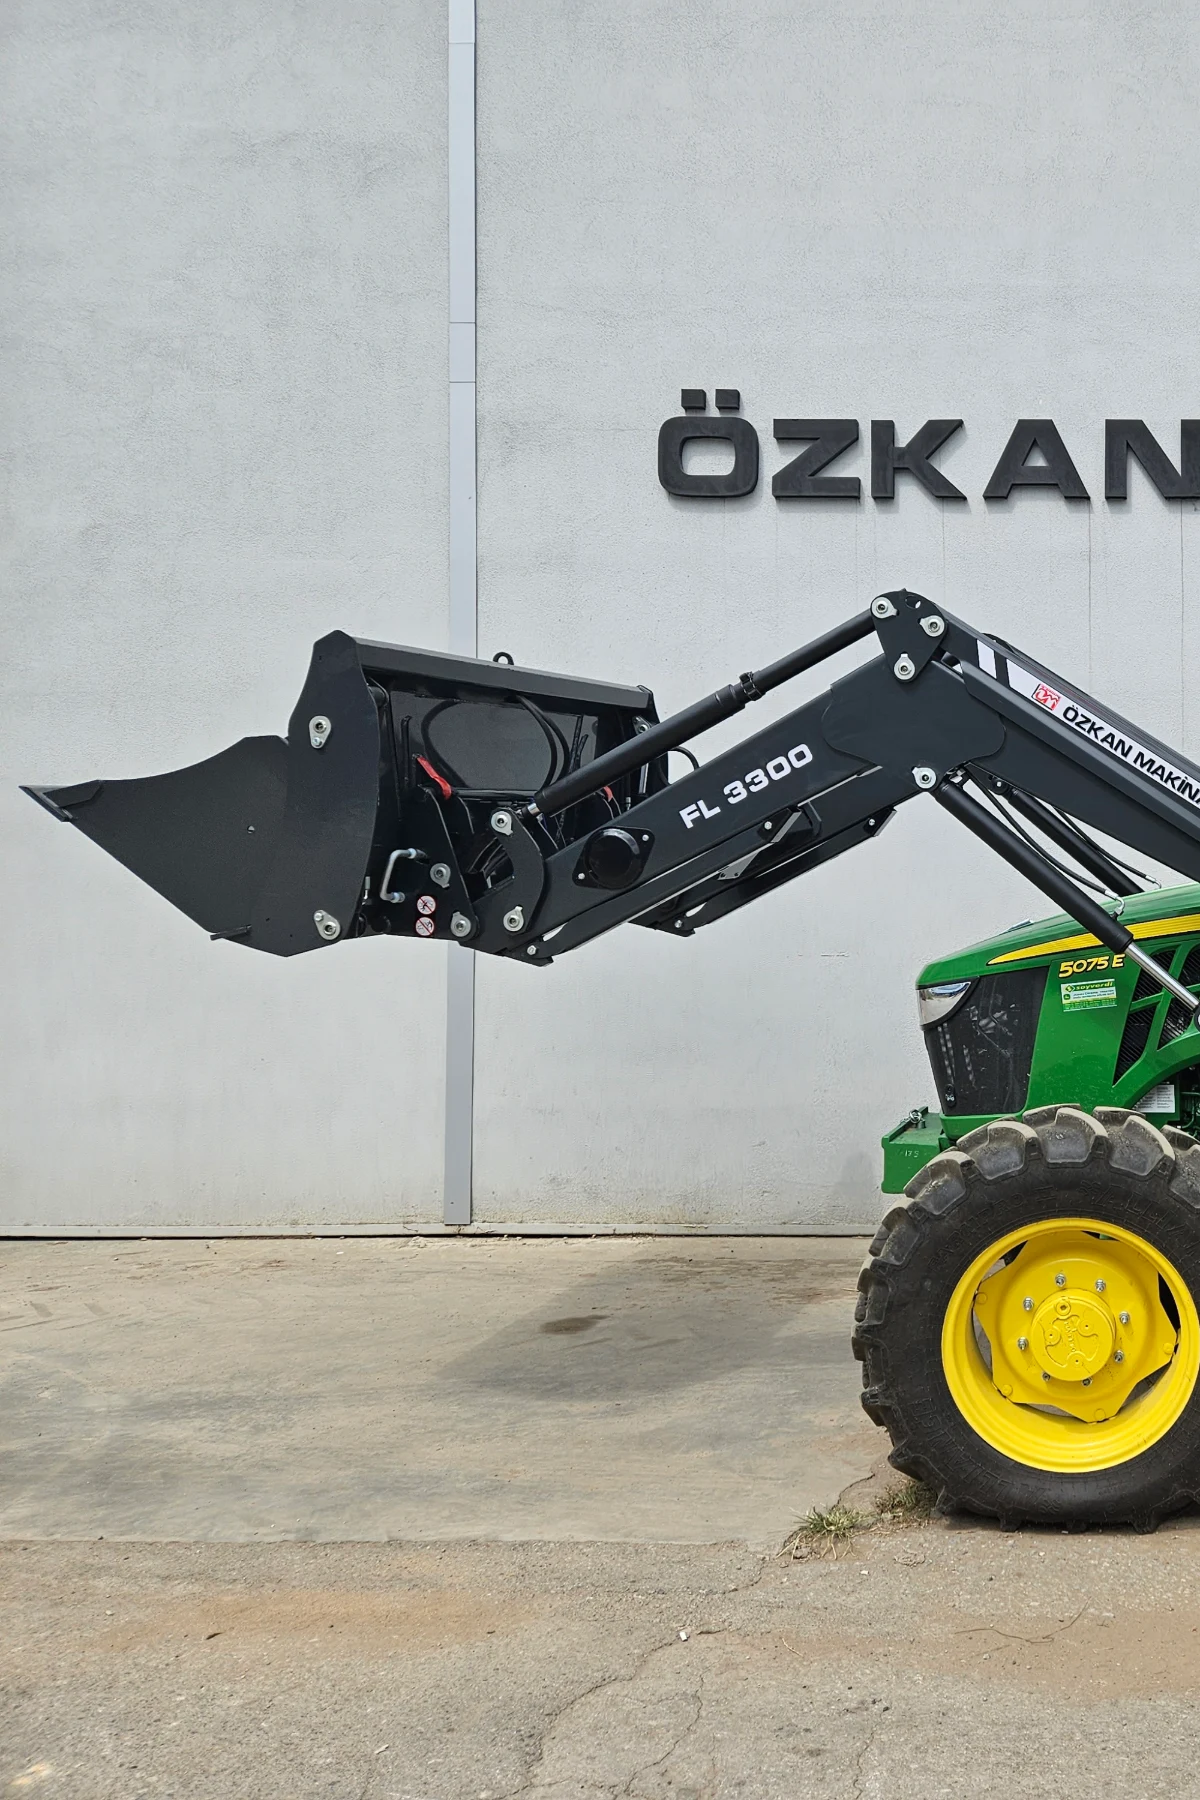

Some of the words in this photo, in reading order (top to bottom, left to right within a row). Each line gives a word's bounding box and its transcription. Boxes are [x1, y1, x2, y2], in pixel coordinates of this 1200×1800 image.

[1062, 704, 1133, 762] ÖZKAN
[679, 798, 721, 829] FL
[723, 742, 814, 807] 3300
[1058, 955, 1110, 978] 5075
[1111, 953, 1126, 968] E
